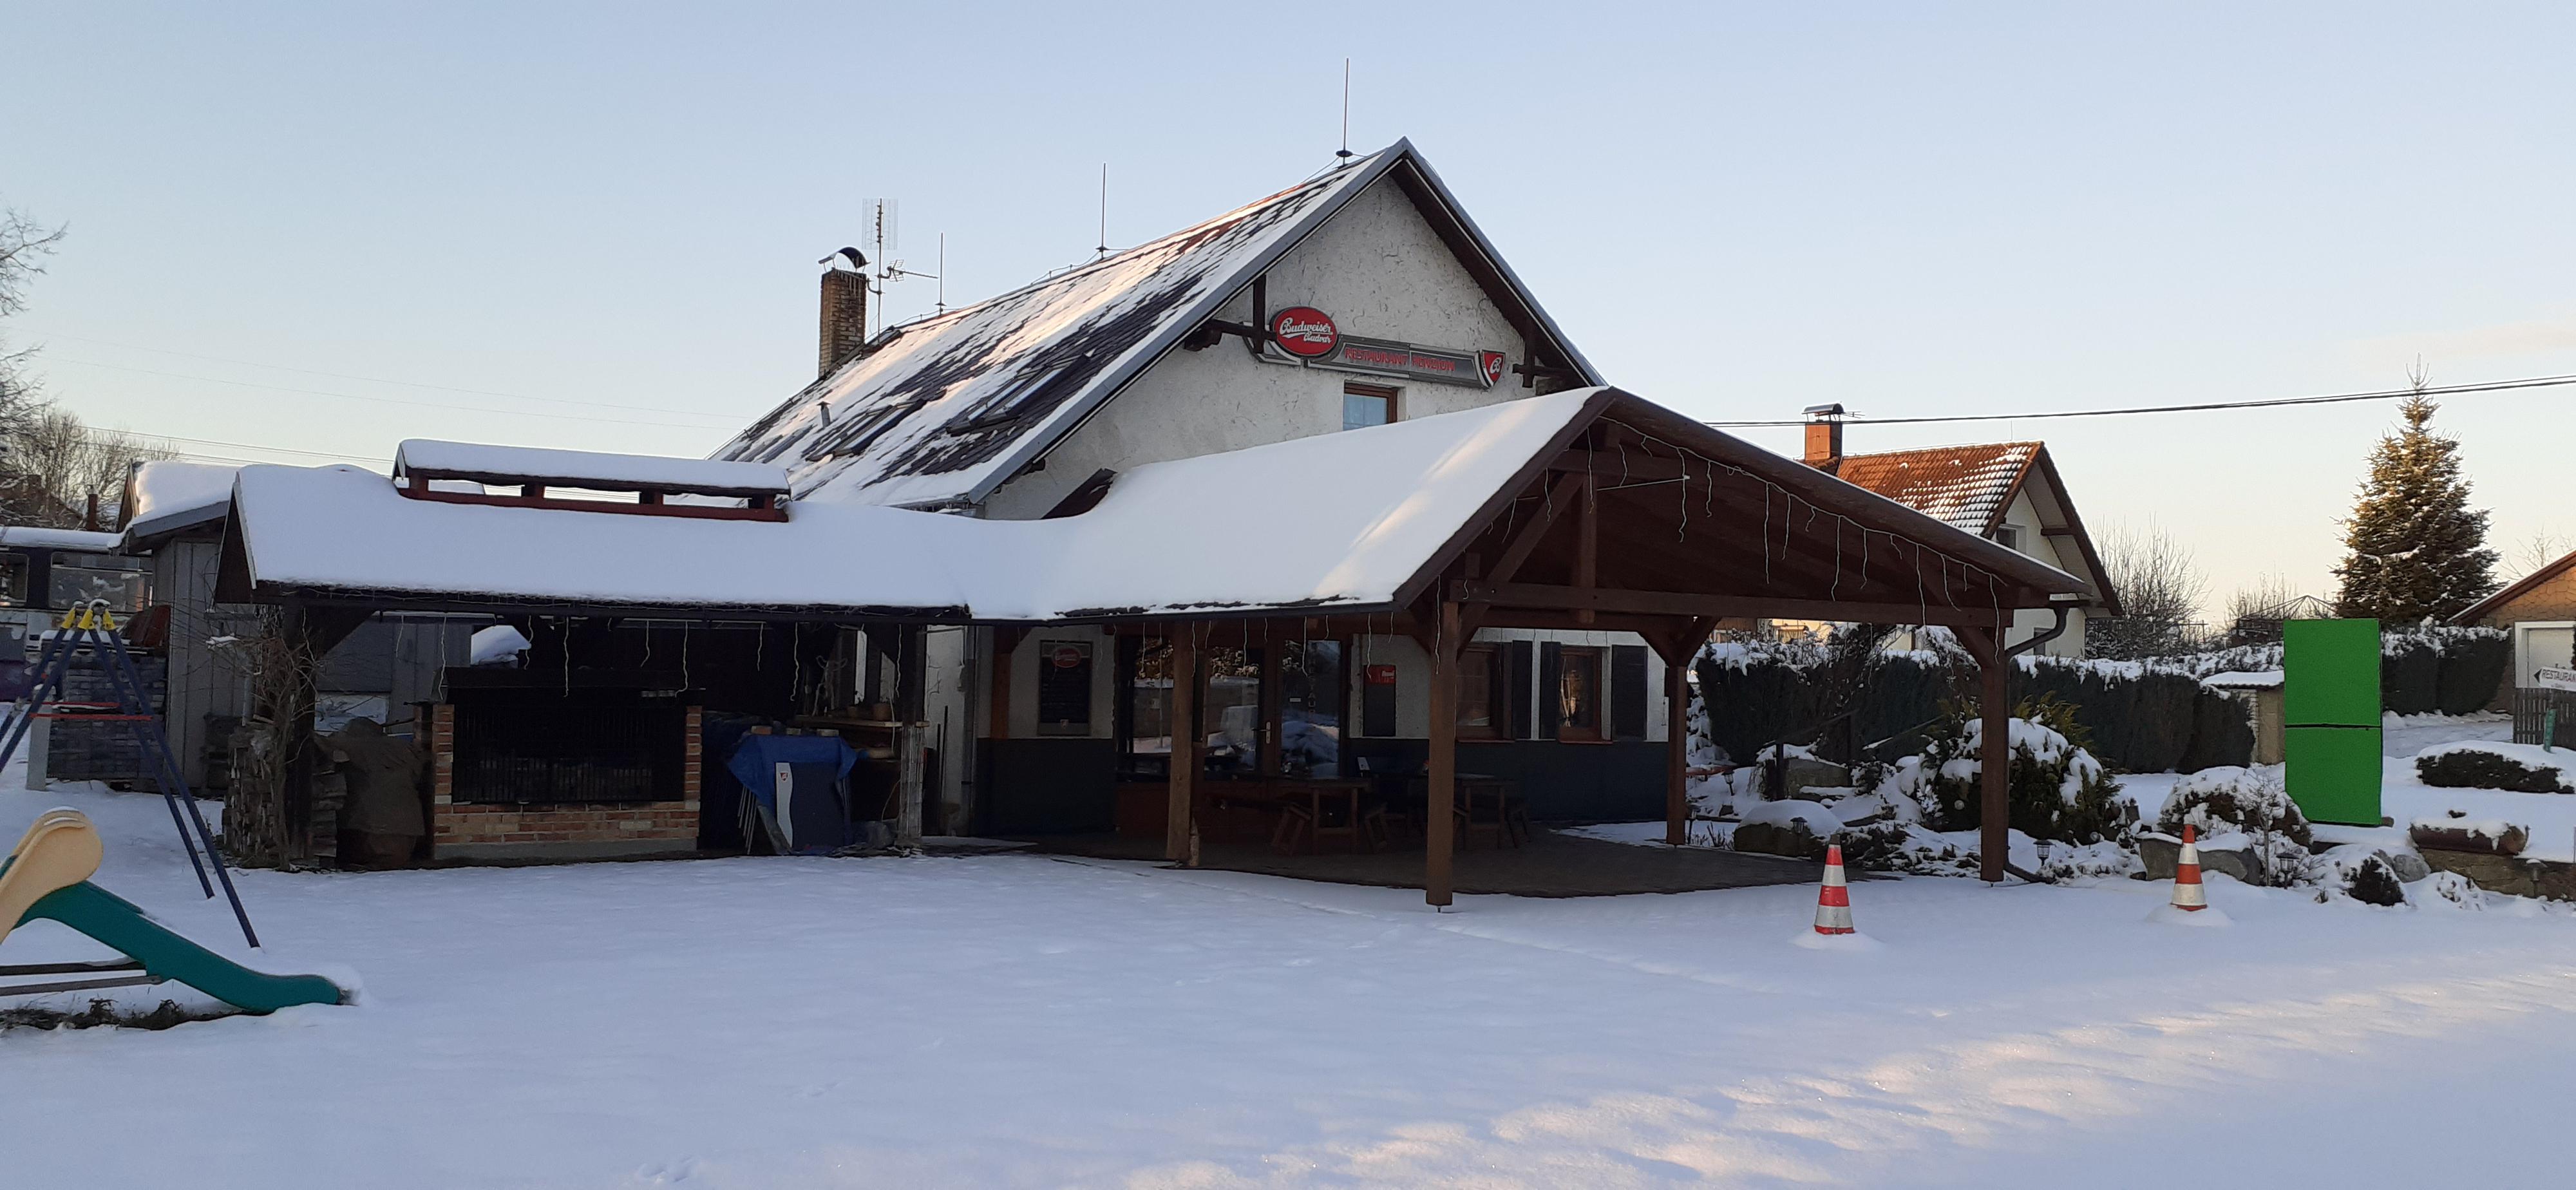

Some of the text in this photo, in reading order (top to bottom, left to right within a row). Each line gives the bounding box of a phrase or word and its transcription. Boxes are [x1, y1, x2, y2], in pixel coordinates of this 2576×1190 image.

[1280, 317, 1332, 335] Budweiser
[1303, 331, 1332, 344] Budvar
[1345, 346, 1455, 372] RESTAURANT PENZION
